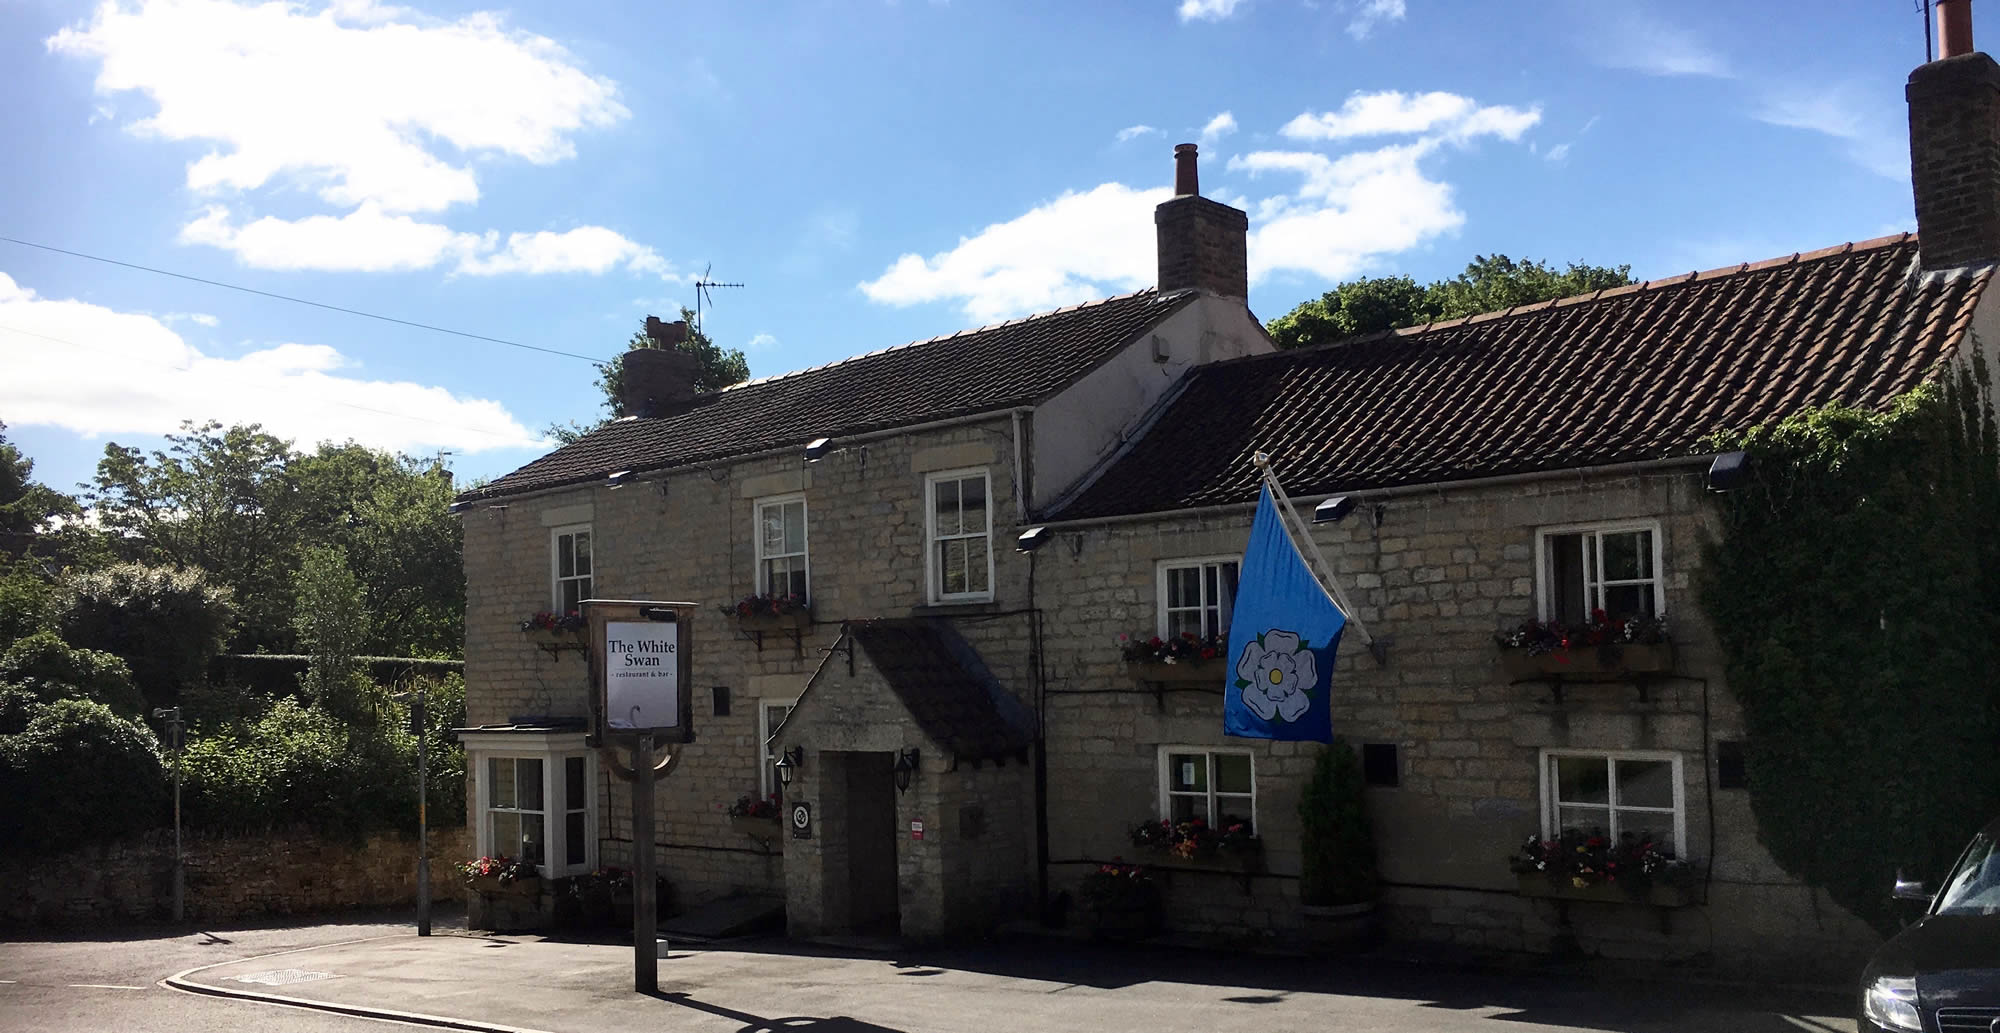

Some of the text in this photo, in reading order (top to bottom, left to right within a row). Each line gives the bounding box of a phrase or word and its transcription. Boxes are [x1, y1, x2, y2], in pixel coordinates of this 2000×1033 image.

[608, 640, 675, 653] The White
[625, 654, 660, 667] Swan
